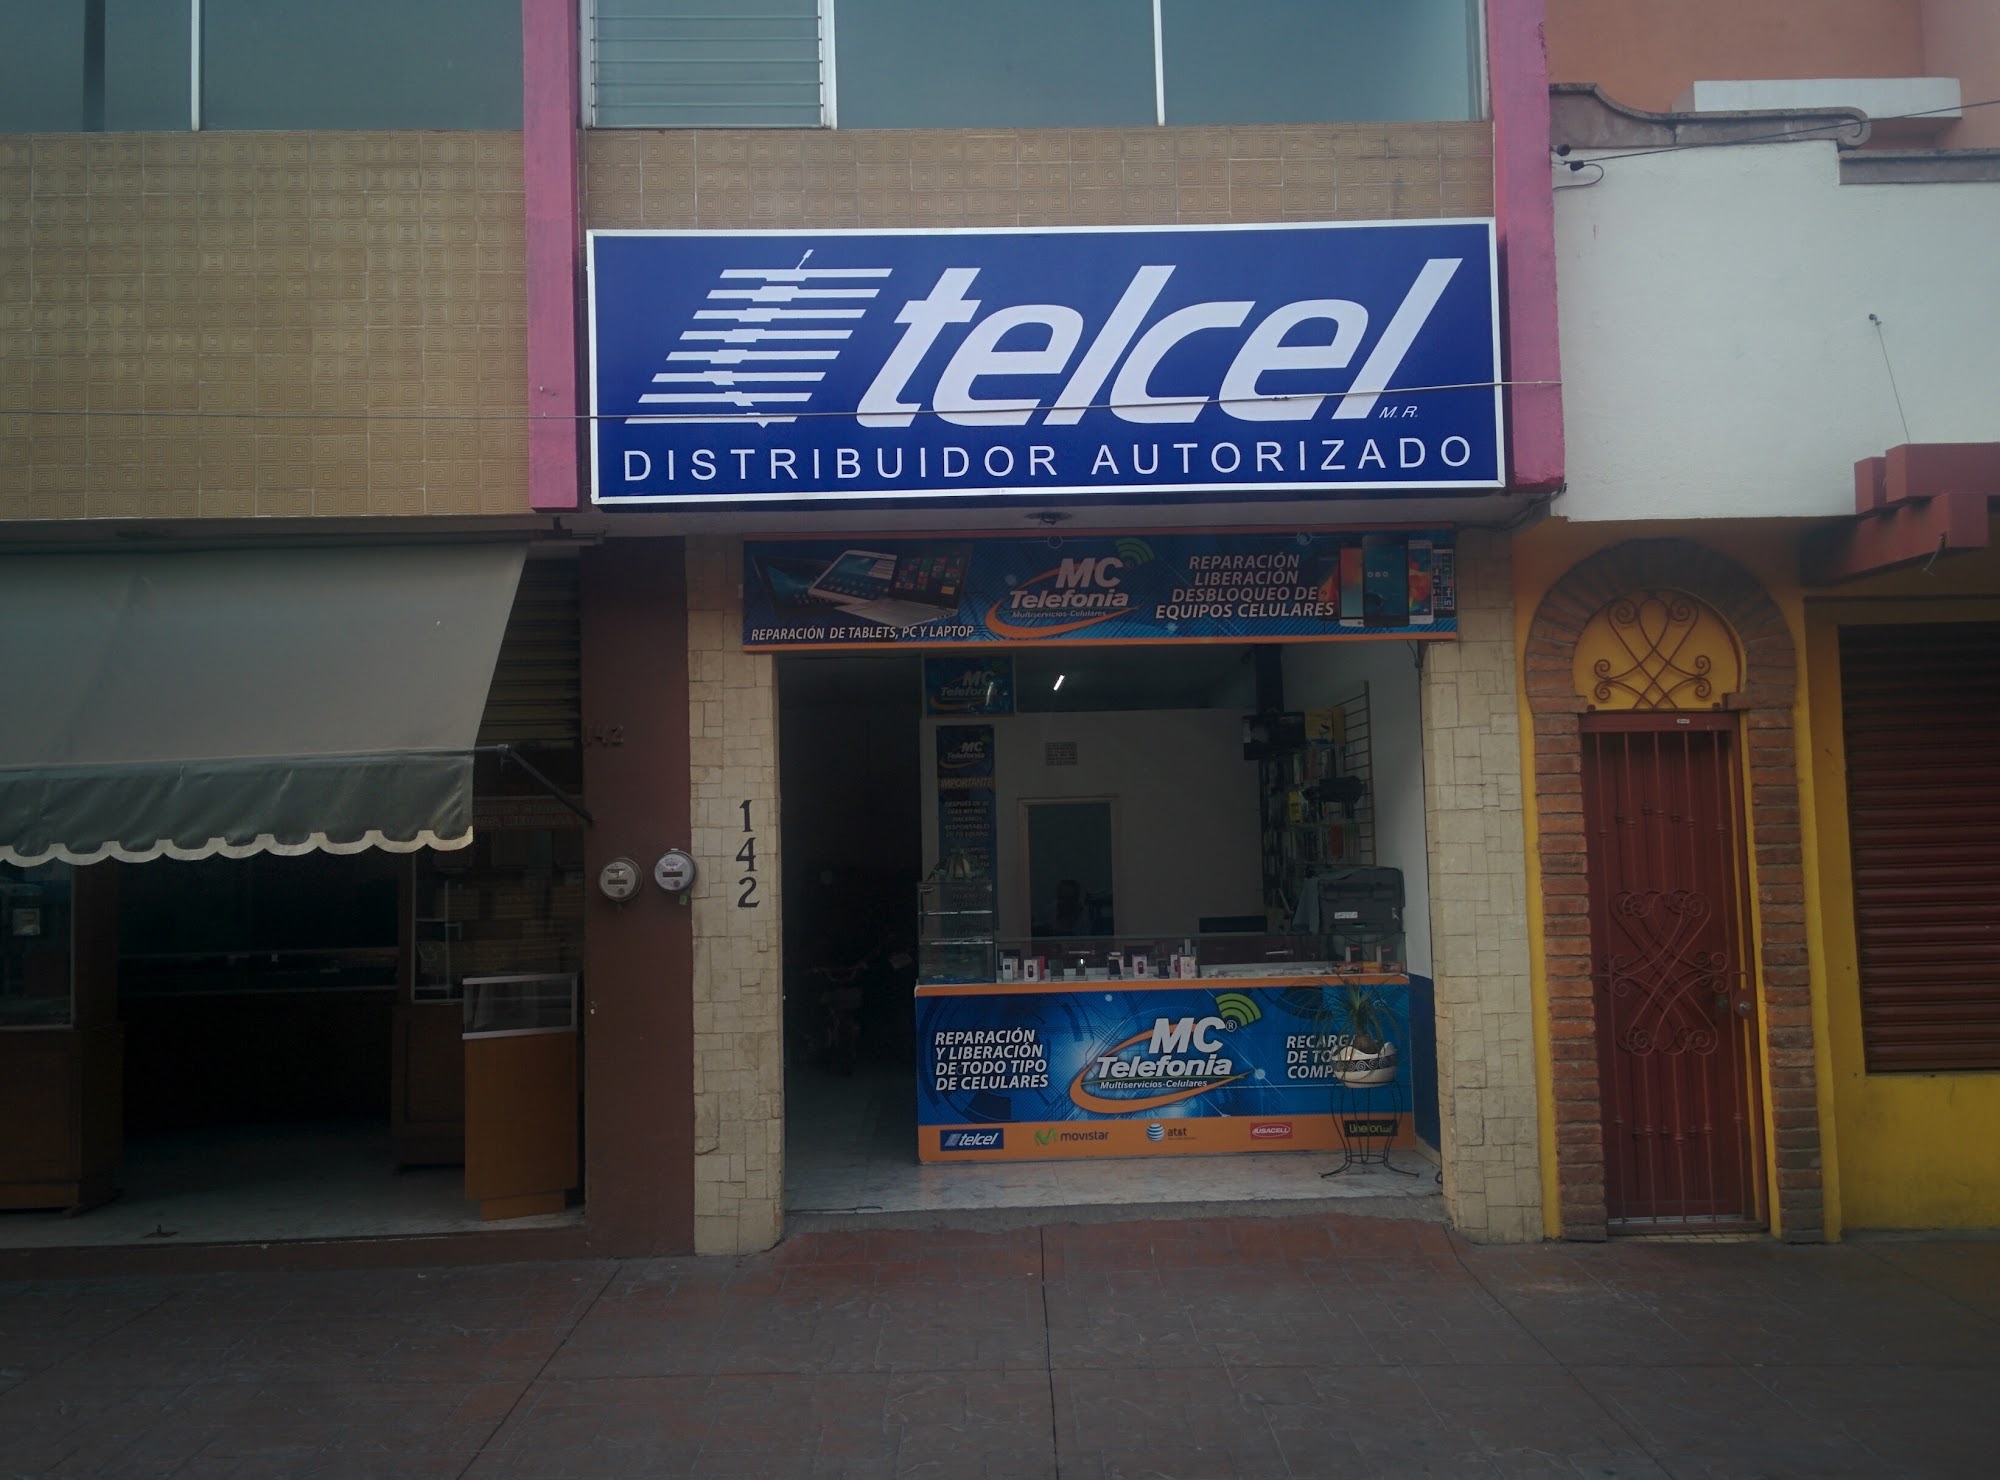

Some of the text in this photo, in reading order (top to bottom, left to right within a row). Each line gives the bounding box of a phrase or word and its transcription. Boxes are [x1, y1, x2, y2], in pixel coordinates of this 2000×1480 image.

[856, 258, 1463, 428] telcel
[624, 436, 1471, 481] DISTRIBUIDOR AUTORIZADO
[1189, 552, 1300, 569] REPARACIÓN
[1055, 557, 1123, 588] MC
[1194, 570, 1299, 586] LIBERACIÓN
[1009, 589, 1129, 609] Telefonia
[1172, 586, 1318, 602] DESBLOQUEO DE
[1155, 602, 1335, 620] EQUIPOS CELULARES
[751, 624, 974, 641] REPARACIÓN DE TABLETS, PC Y LAPTOP
[962, 670, 996, 687] MC
[940, 687, 997, 698] Telefona
[961, 741, 983, 752] MC
[940, 777, 993, 788] IMPORTANTE
[735, 799, 760, 908] 142
[935, 1027, 1036, 1046] REPARACIÓN
[1149, 1016, 1226, 1054] MC
[936, 1042, 1043, 1060] Y LIBERACIÓN
[1287, 1051, 1309, 1064] DE
[936, 1059, 1047, 1076] DE TODO TIPO
[1096, 1052, 1233, 1078] Telefonia
[936, 1074, 1049, 1091] DE CELULARES
[959, 1132, 999, 1147] telcel
[1060, 1130, 1109, 1141] movistar
